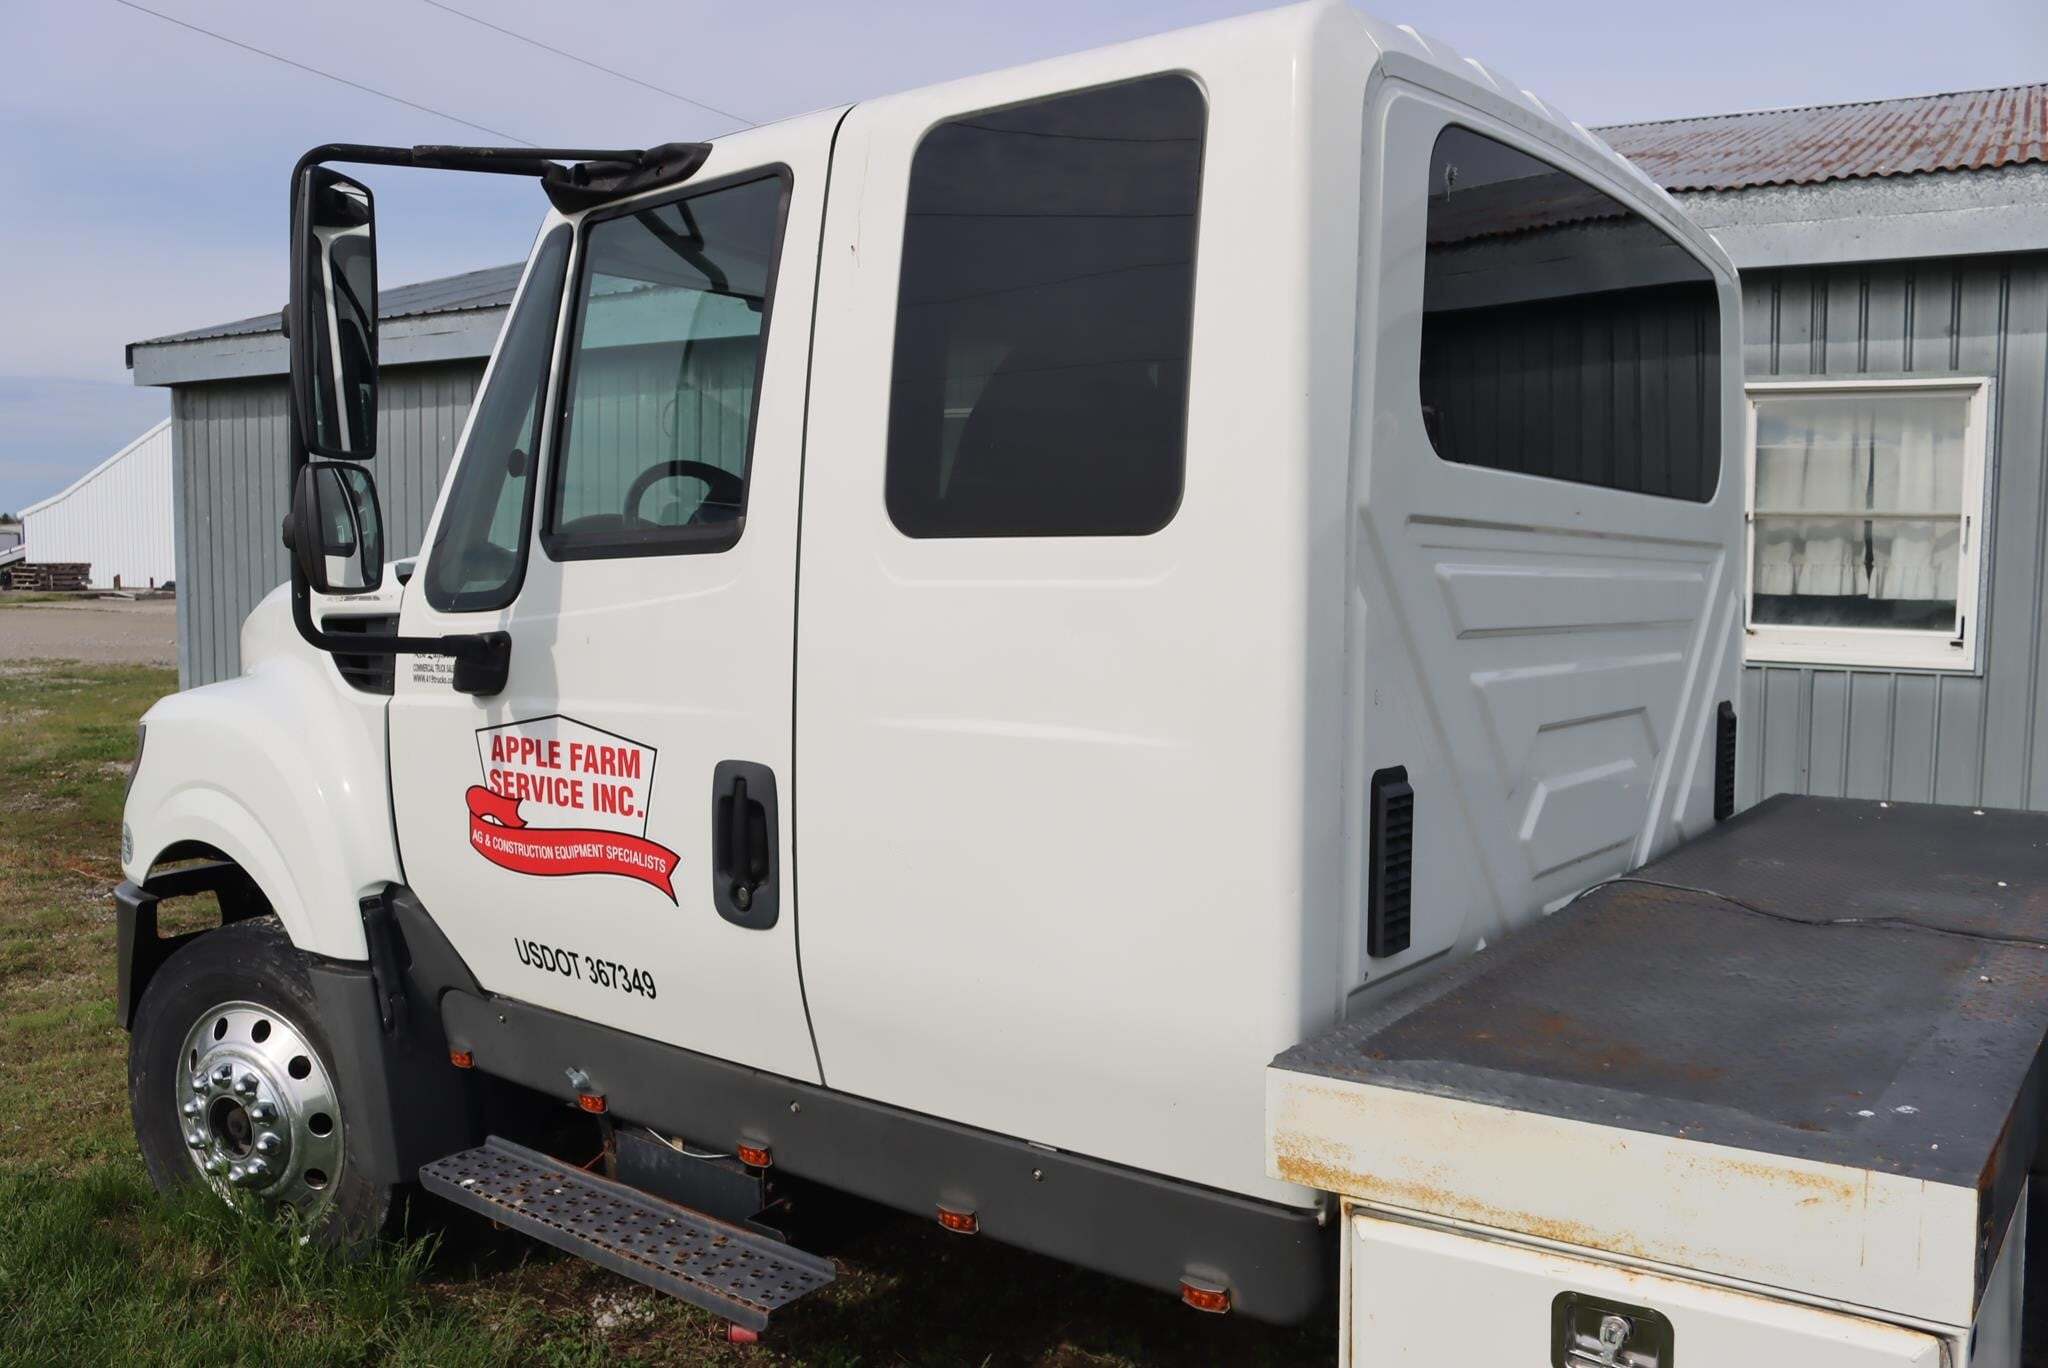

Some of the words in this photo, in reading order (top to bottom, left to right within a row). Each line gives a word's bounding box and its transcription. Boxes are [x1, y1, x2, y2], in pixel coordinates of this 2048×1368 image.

[491, 735, 561, 769] APPLE
[569, 743, 641, 779] FARM
[489, 769, 584, 809] SERVICE
[592, 782, 643, 818] INC.
[472, 829, 483, 844] AG
[485, 834, 491, 847] &
[492, 837, 553, 859] CONSTRUCTION
[555, 844, 604, 860] EQUIPMENT
[606, 846, 666, 873] SPECIALISTS
[514, 937, 581, 980] USDOT
[585, 956, 657, 1000] 367349
